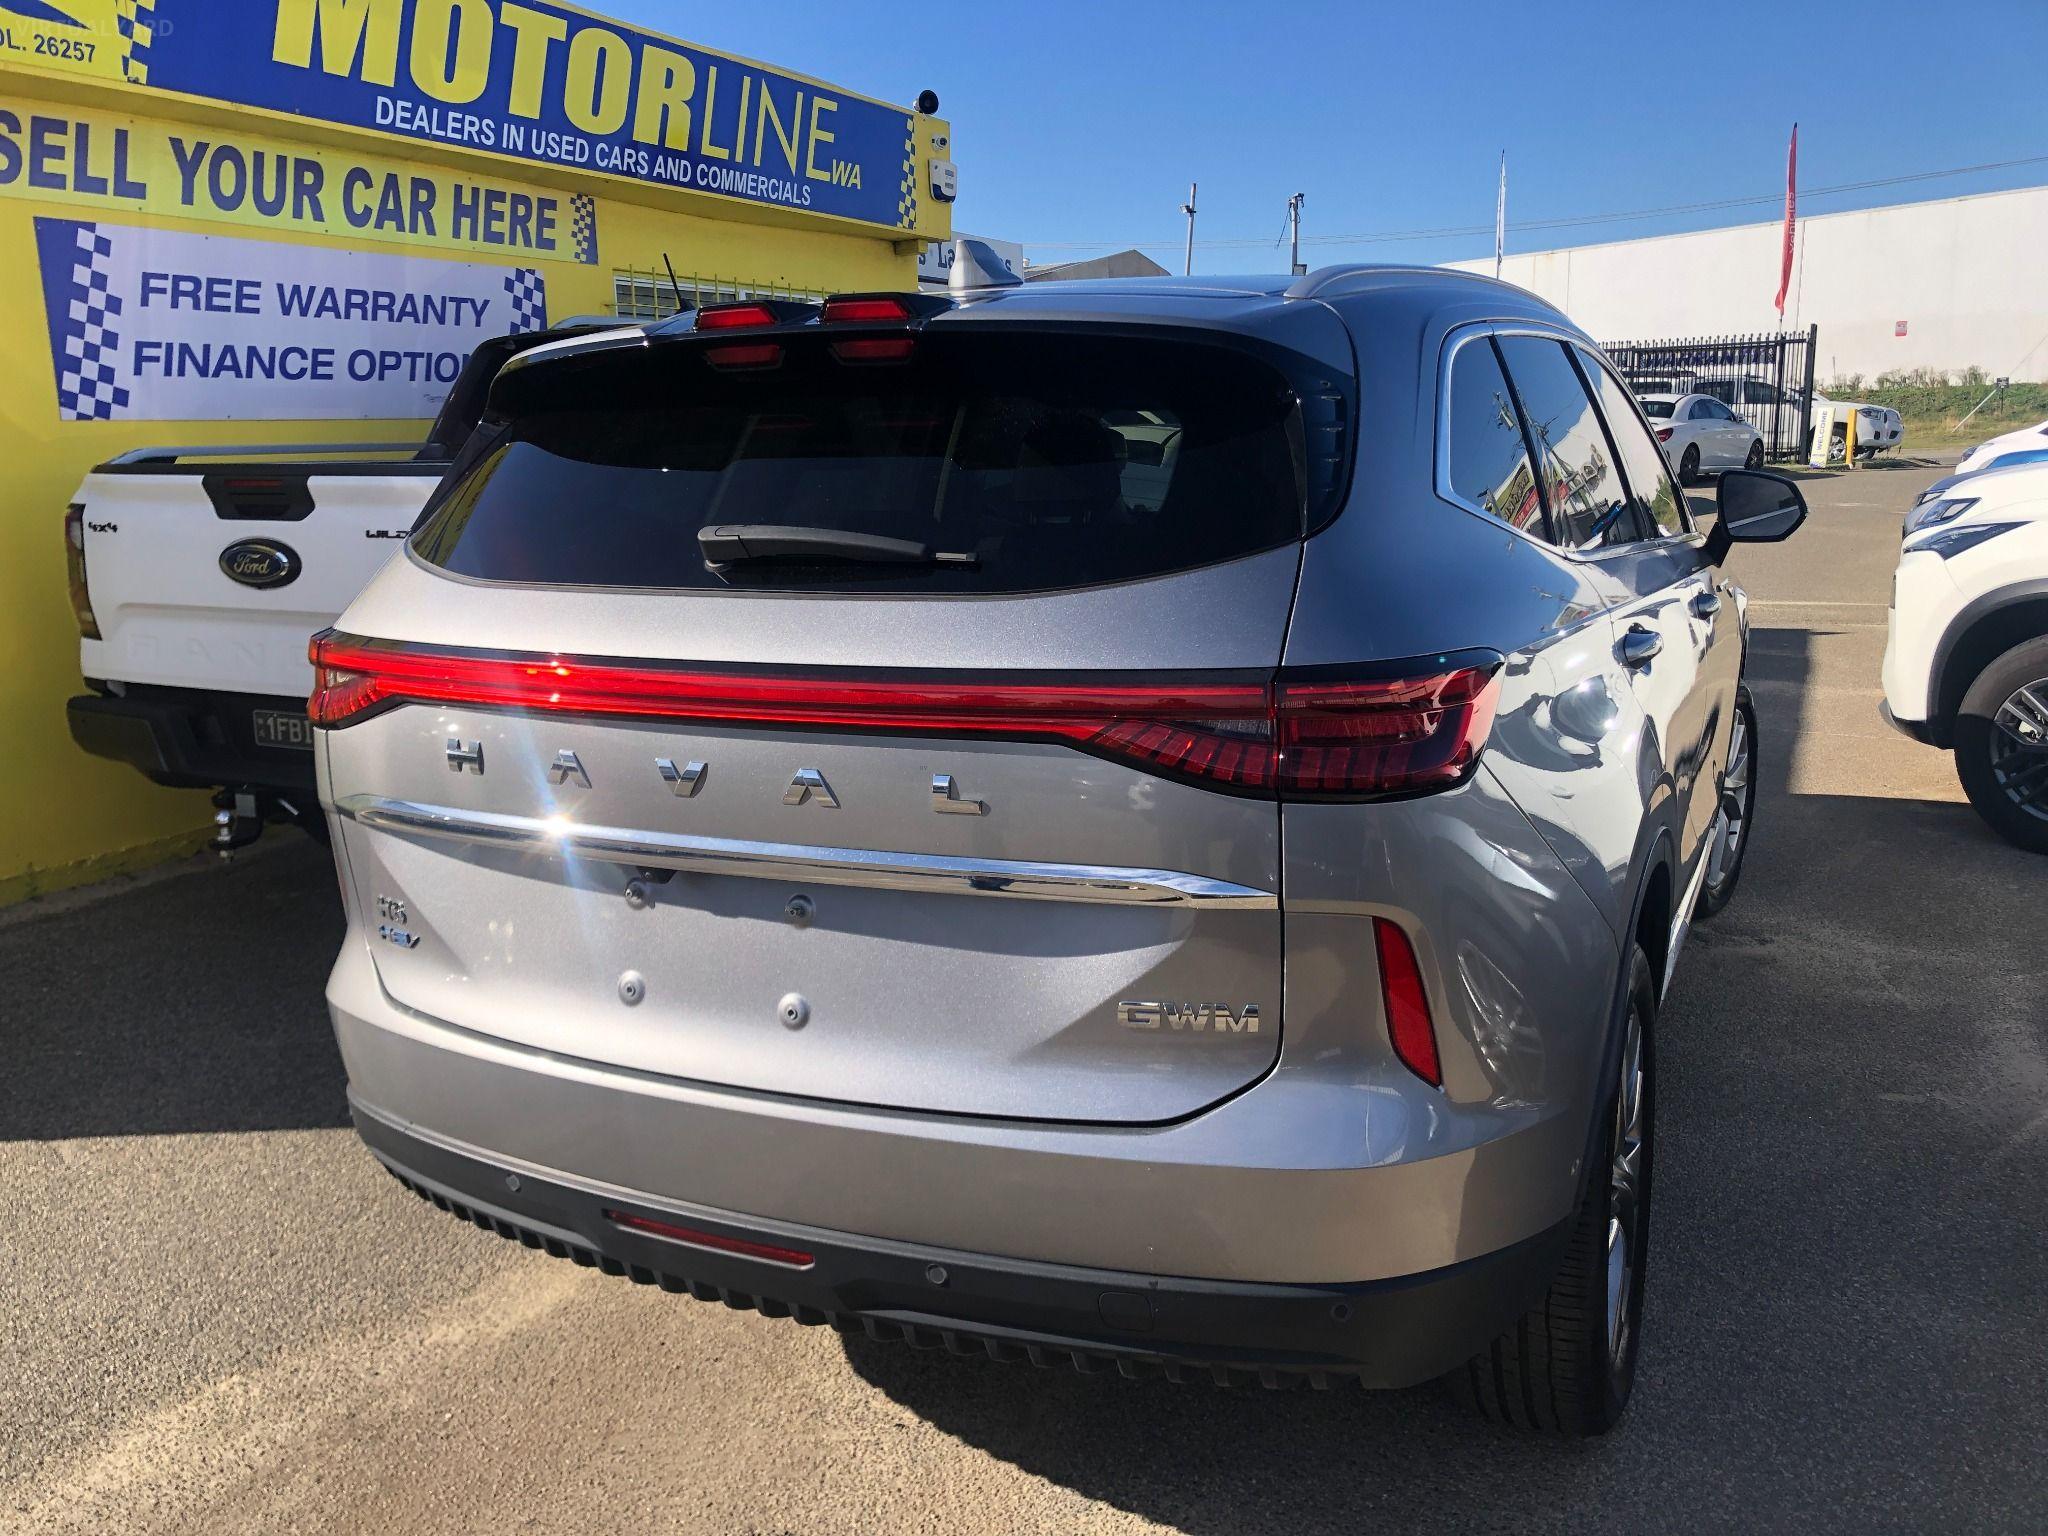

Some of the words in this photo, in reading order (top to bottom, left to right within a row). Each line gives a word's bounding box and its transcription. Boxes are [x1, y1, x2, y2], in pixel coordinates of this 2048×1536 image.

[33, 33, 96, 63] 26257
[375, 95, 496, 146] DEALERS
[502, 123, 525, 152] IN
[531, 128, 590, 163] USED
[595, 142, 649, 175] CARS
[652, 155, 692, 183] AND
[696, 163, 811, 206] COMMERCIALS
[0, 109, 147, 200] SELL
[168, 136, 325, 224] YOUR
[342, 166, 437, 237] CAR
[452, 183, 557, 251] HERE
[831, 158, 862, 190] WA
[139, 272, 262, 315] FREE
[276, 283, 490, 328] WARRANTY
[132, 340, 335, 381] FINANCE
[233, 551, 270, 575] Ford
[446, 738, 988, 816] HAVAL
[1117, 1001, 1260, 1033] GWM
